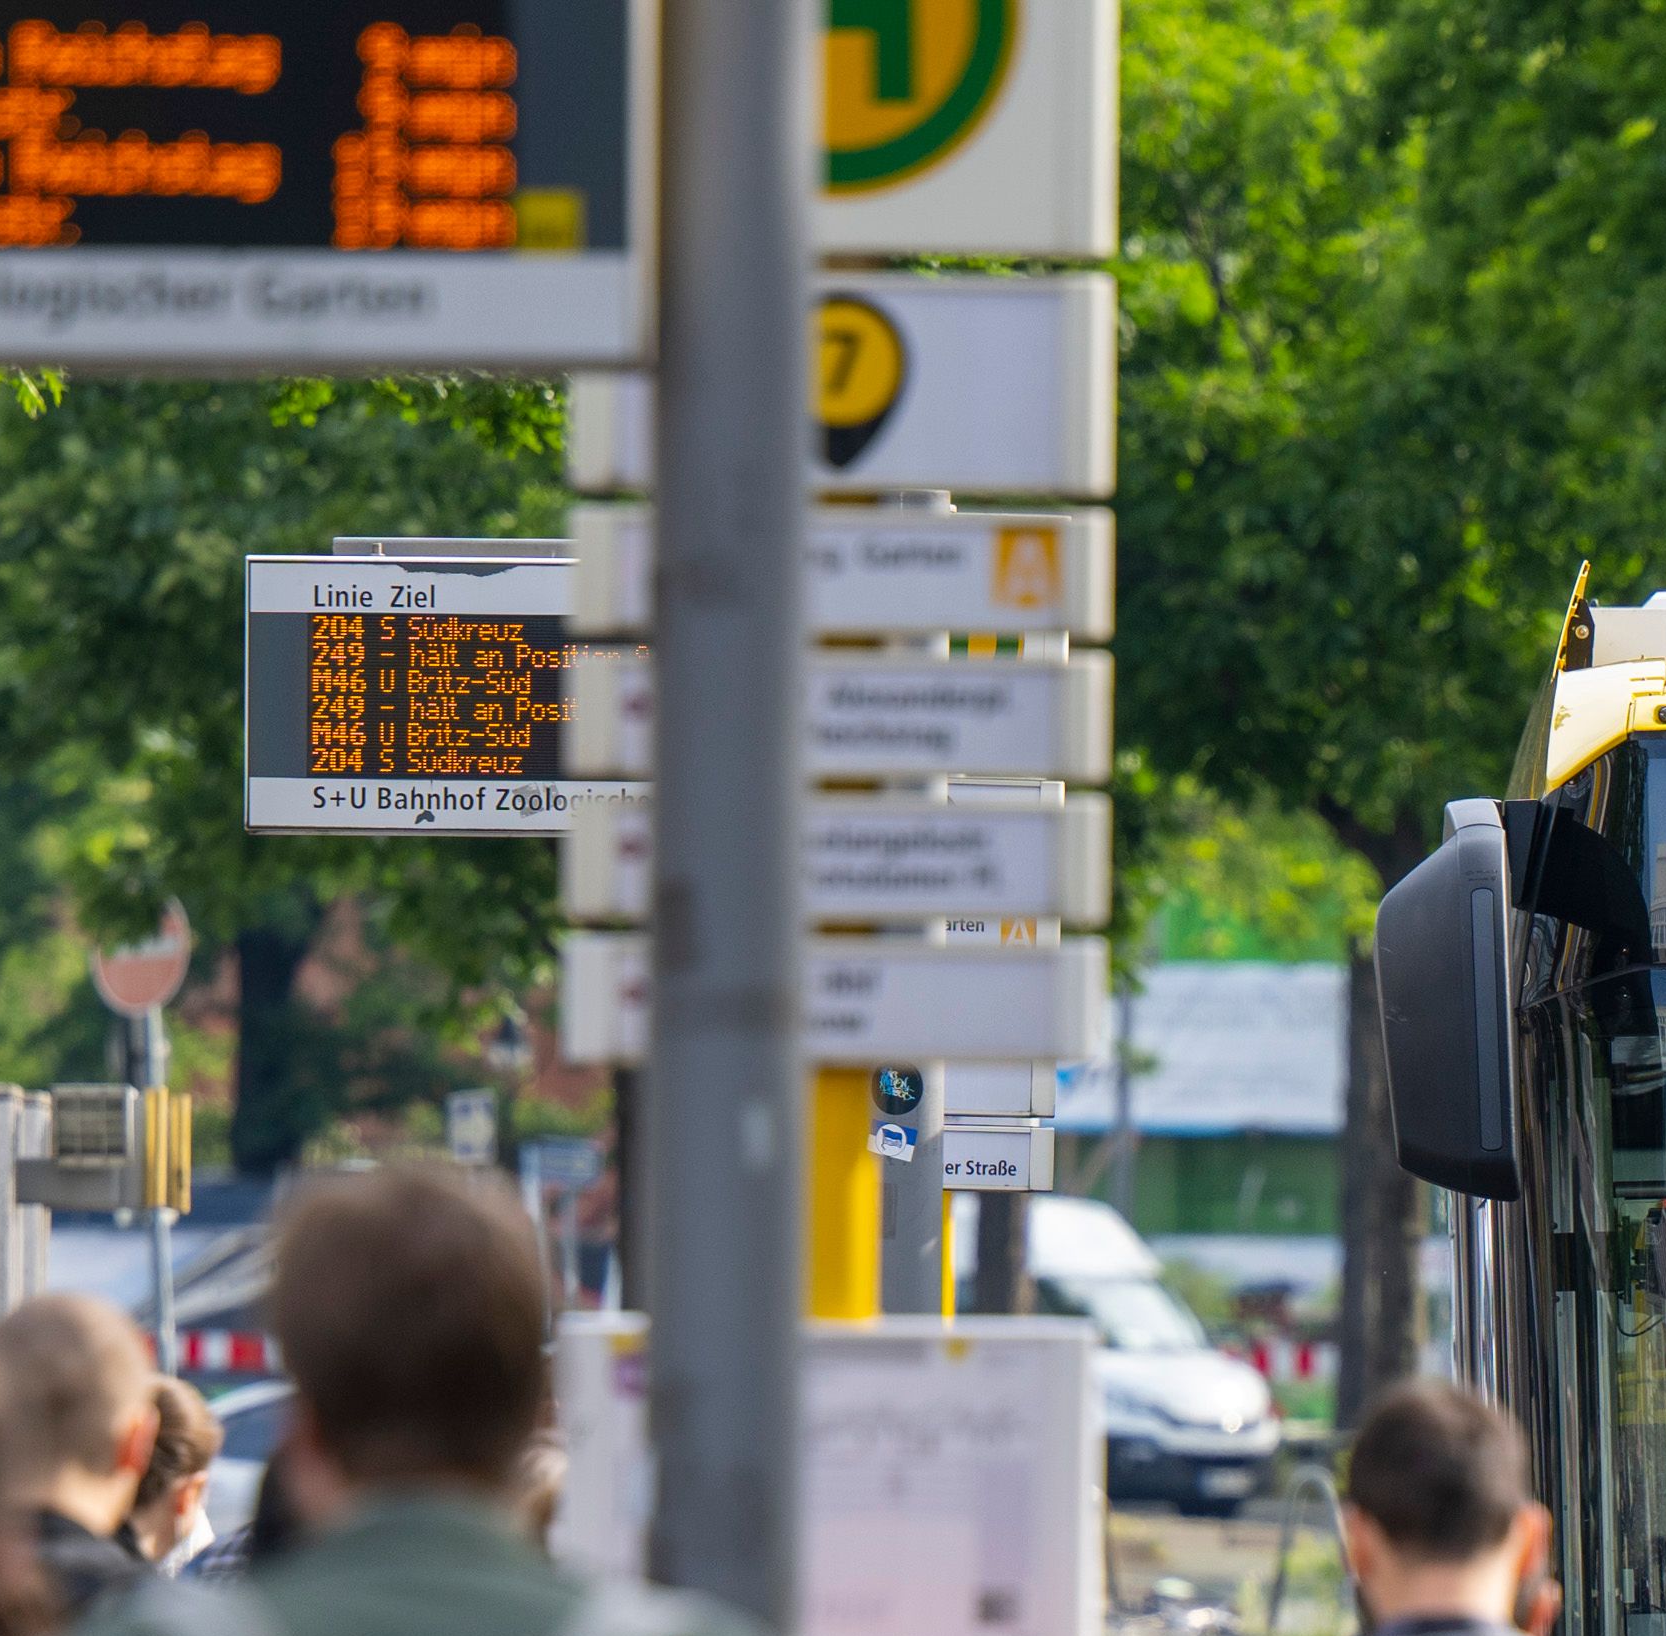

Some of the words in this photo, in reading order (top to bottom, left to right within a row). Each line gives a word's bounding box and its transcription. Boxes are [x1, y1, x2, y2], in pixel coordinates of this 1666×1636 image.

[313, 584, 373, 608] Linie
[390, 584, 436, 608] Ziel
[311, 615, 366, 640] 204
[380, 616, 396, 640] S
[407, 616, 525, 642] Südkreuz
[311, 641, 366, 666] 249
[409, 643, 461, 668] hält
[473, 650, 504, 668] an
[311, 668, 368, 693] M46
[380, 668, 396, 693] U
[407, 669, 532, 695] Britz-Süd
[311, 694, 366, 719] 249
[409, 696, 461, 720] hält
[473, 702, 504, 721] an
[311, 721, 368, 746] M46
[380, 721, 396, 746] U
[407, 722, 532, 747] Britz-Süd
[311, 747, 366, 773] 204
[379, 748, 395, 773] S
[407, 748, 524, 774] Südkreuz
[313, 785, 367, 809] S+U
[377, 785, 487, 811] Bahnhof
[965, 1159, 1017, 1176] Straße
